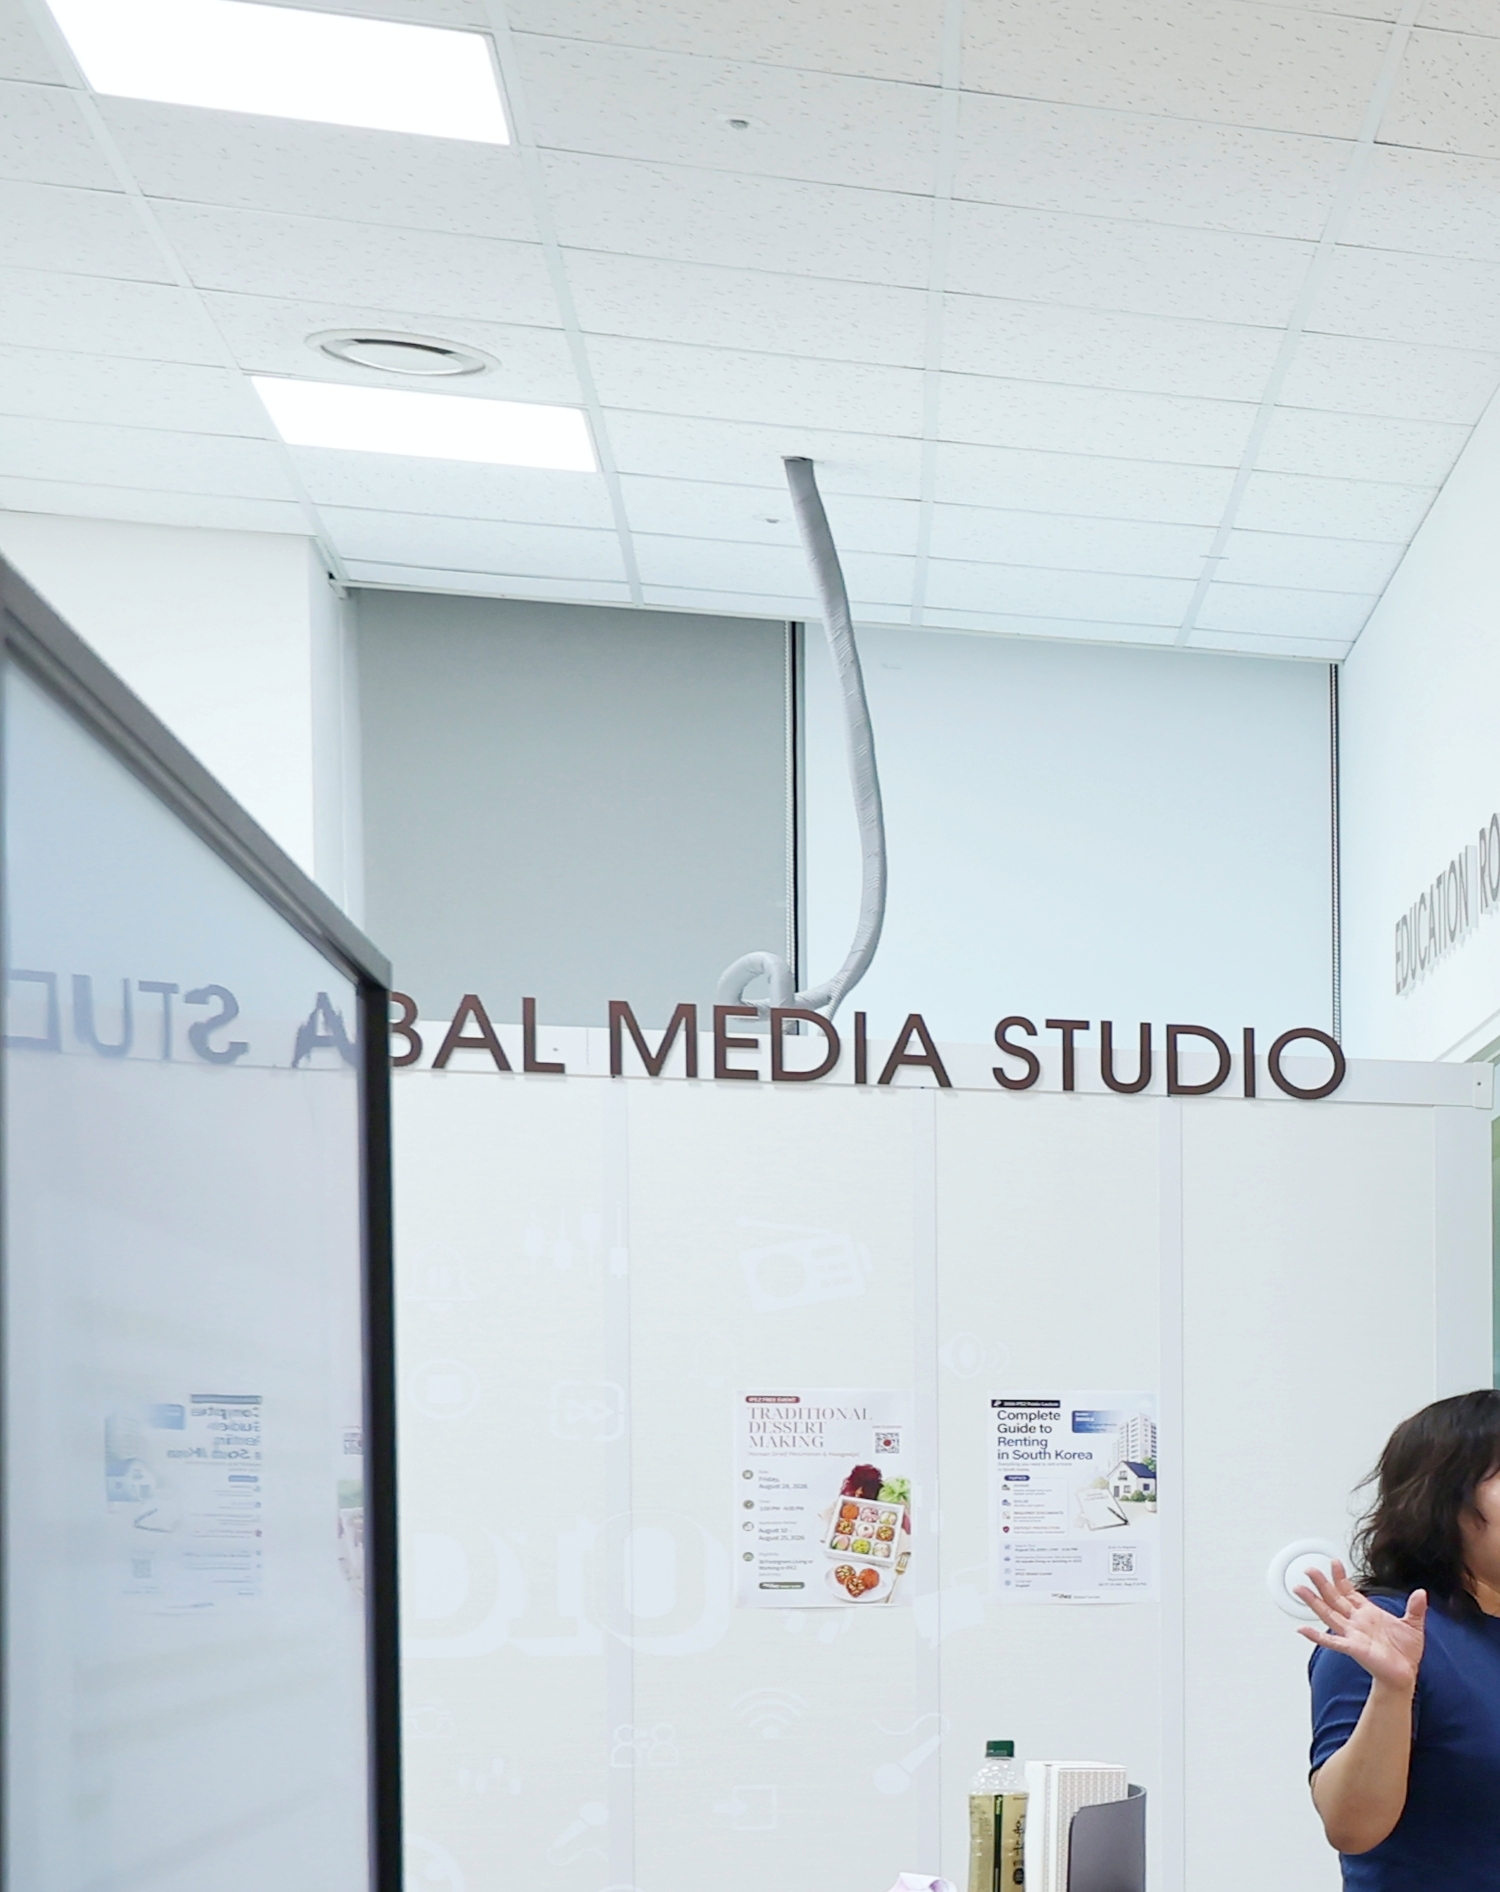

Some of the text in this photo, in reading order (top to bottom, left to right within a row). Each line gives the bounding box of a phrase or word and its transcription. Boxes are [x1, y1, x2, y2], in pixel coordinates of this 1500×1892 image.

[1396, 845, 1474, 995] EDUCATION
[608, 999, 953, 1090] MEDIA
[991, 1014, 1348, 1101] STUDIO
[747, 1407, 873, 1420] TRADITIONAL
[997, 1410, 1061, 1423] Complete
[749, 1421, 827, 1434] DESSERT
[997, 1423, 1052, 1434] Guide to
[749, 1435, 824, 1448] MAKING
[997, 1437, 1048, 1449] Renting
[997, 1449, 1093, 1460] in South Korea
